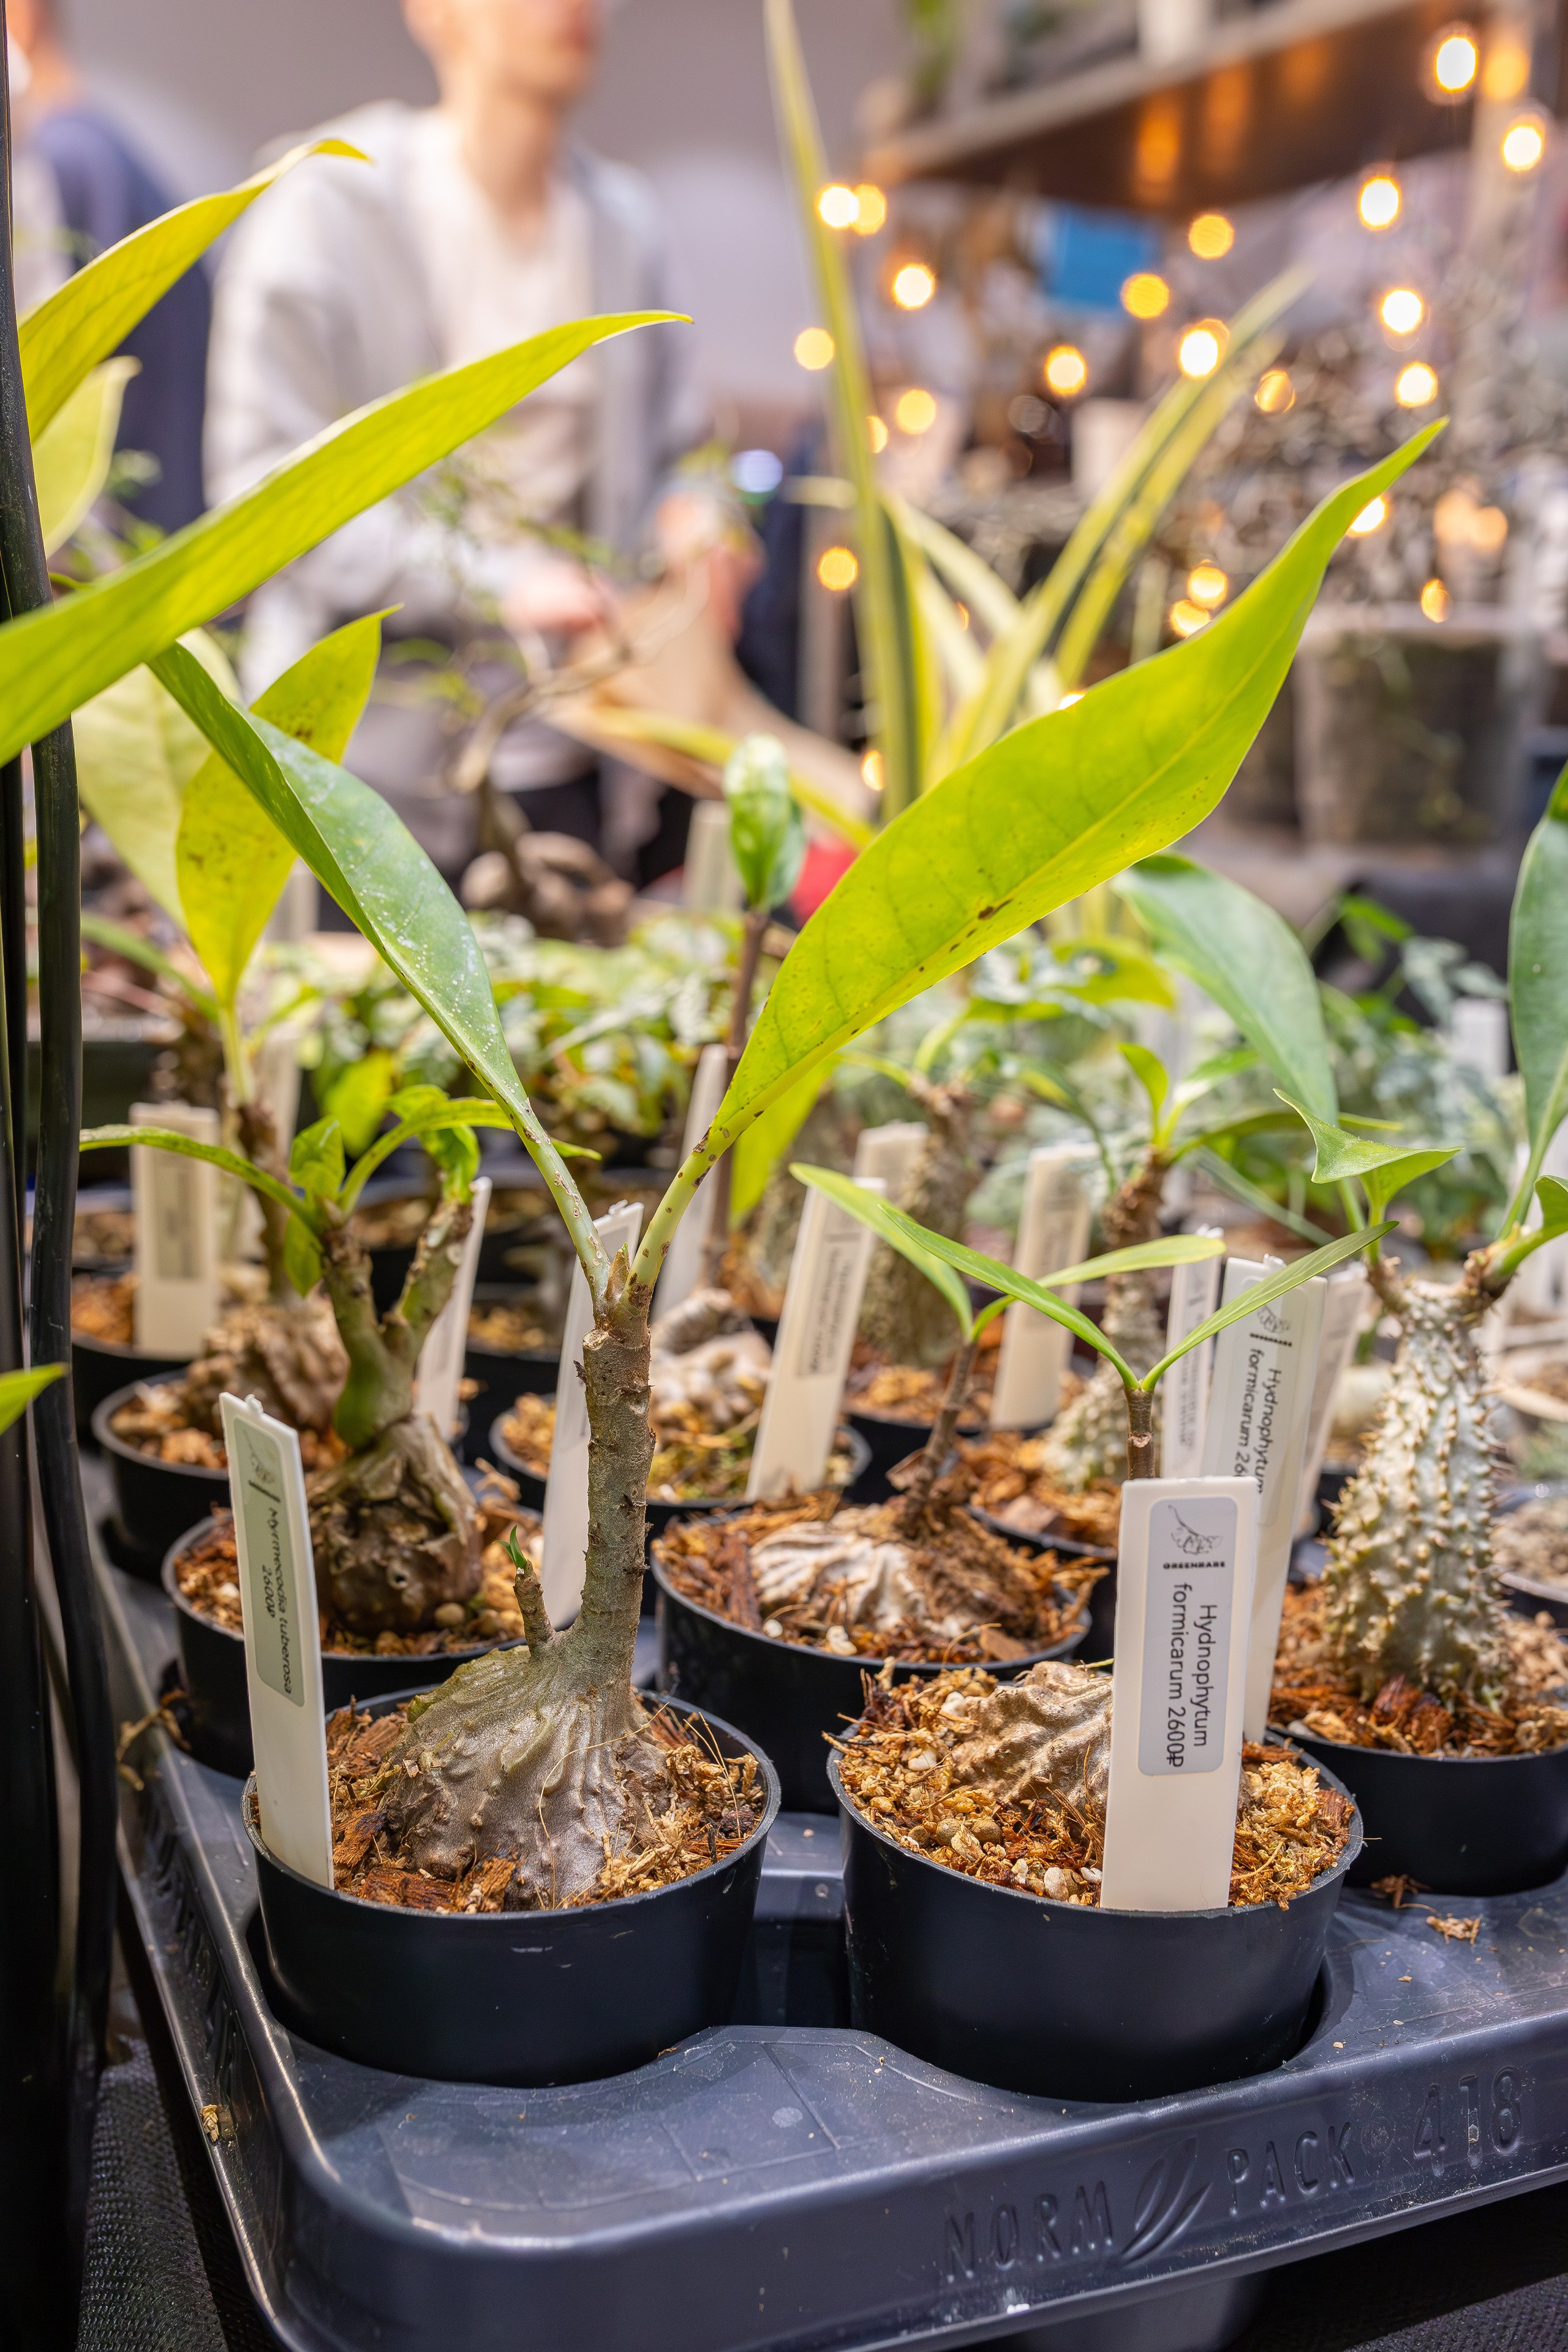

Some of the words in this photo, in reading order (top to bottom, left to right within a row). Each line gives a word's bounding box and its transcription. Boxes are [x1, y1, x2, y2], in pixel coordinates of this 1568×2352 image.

[1238, 1348, 1264, 1447] formicarum
[1234, 1450, 1251, 1477] 26
[268, 1507, 288, 1614] Myrmecodia
[279, 1616, 292, 1695] tuberosa
[1169, 1582, 1193, 1700] formicarum
[1190, 1604, 1218, 1747] Hydnophytum
[944, 2180, 1114, 2283] NORM
[1226, 2121, 1355, 2215] PACK
